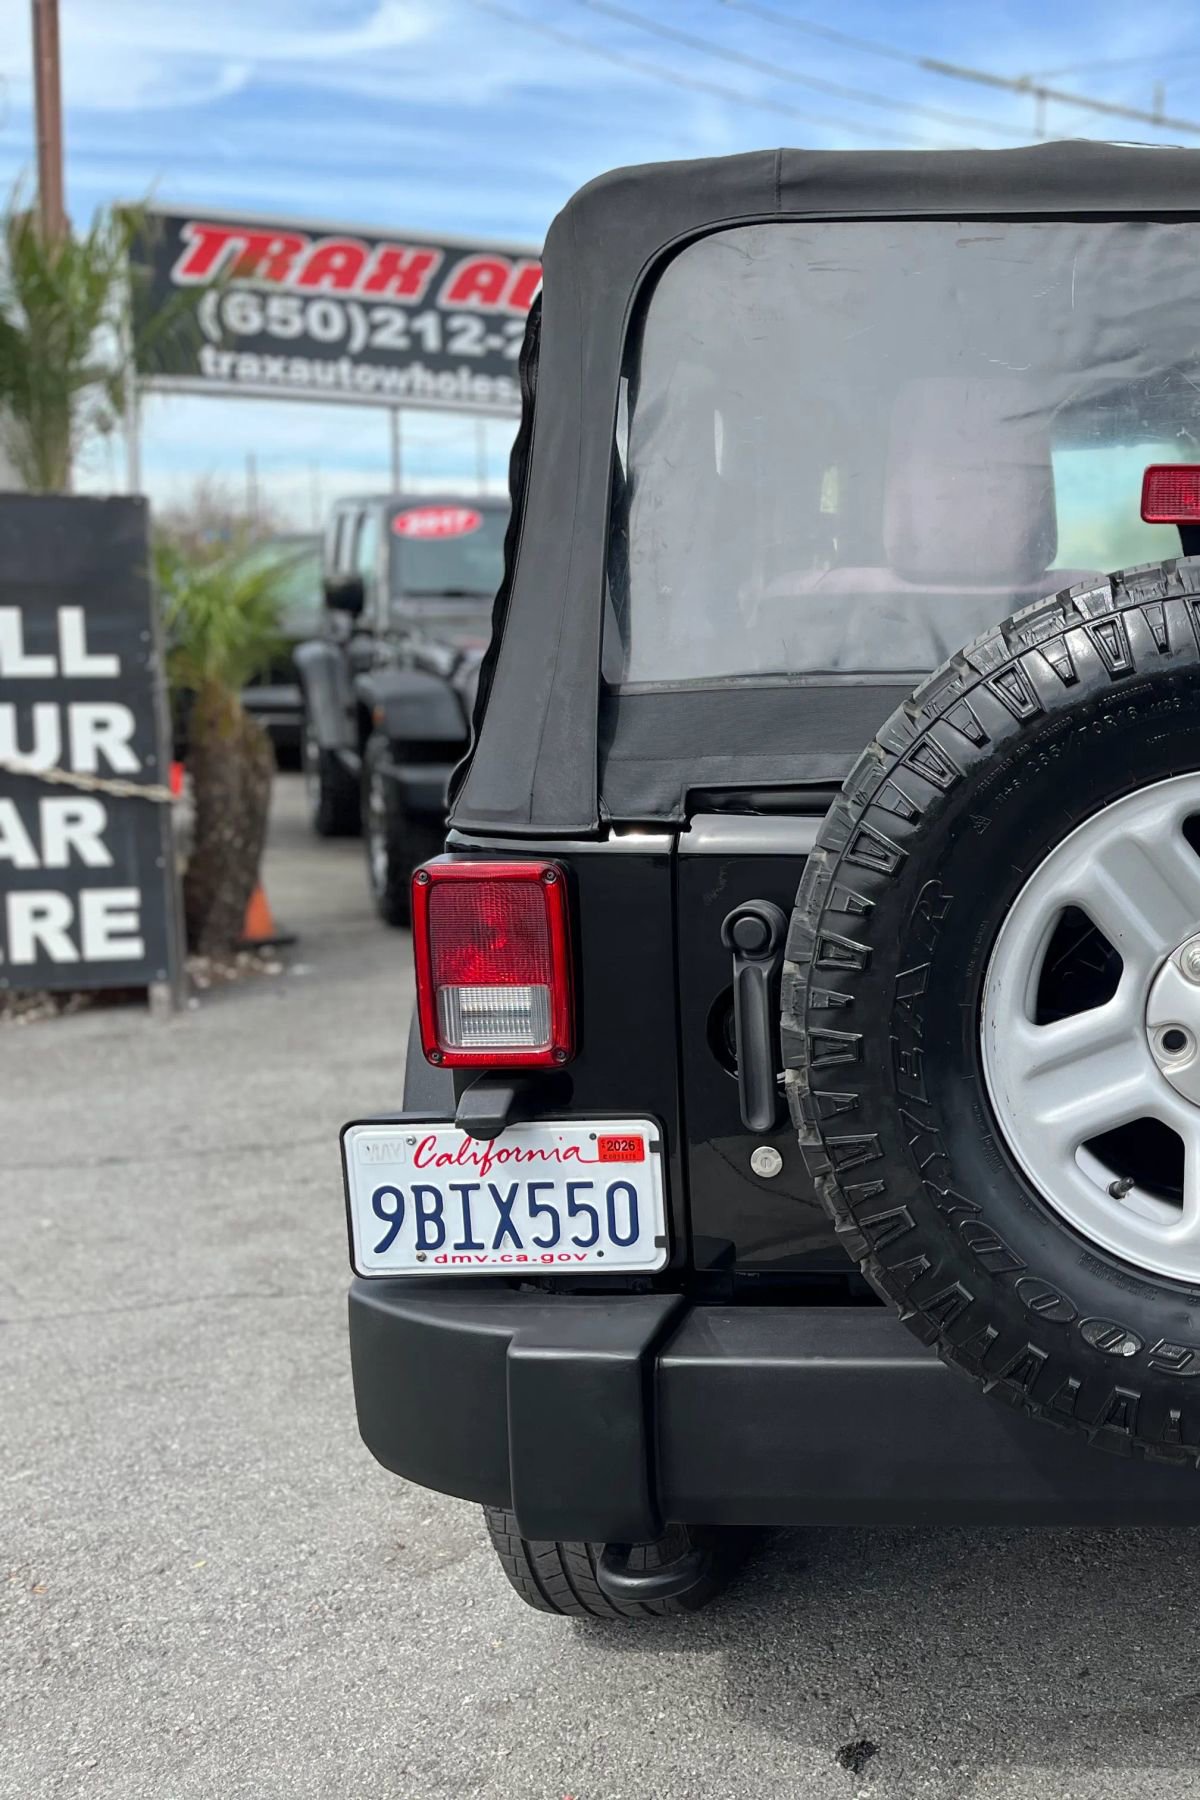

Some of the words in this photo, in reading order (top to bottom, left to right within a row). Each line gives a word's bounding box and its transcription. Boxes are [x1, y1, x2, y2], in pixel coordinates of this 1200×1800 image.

[172, 221, 444, 305] TRAX
[199, 346, 521, 402] traxautowholes
[0, 888, 145, 965] RE
[413, 1133, 599, 1177] California
[606, 1140, 636, 1152] 2026
[371, 1180, 640, 1254] 9BIX550
[434, 1251, 588, 1265] dmv.ca.gov
